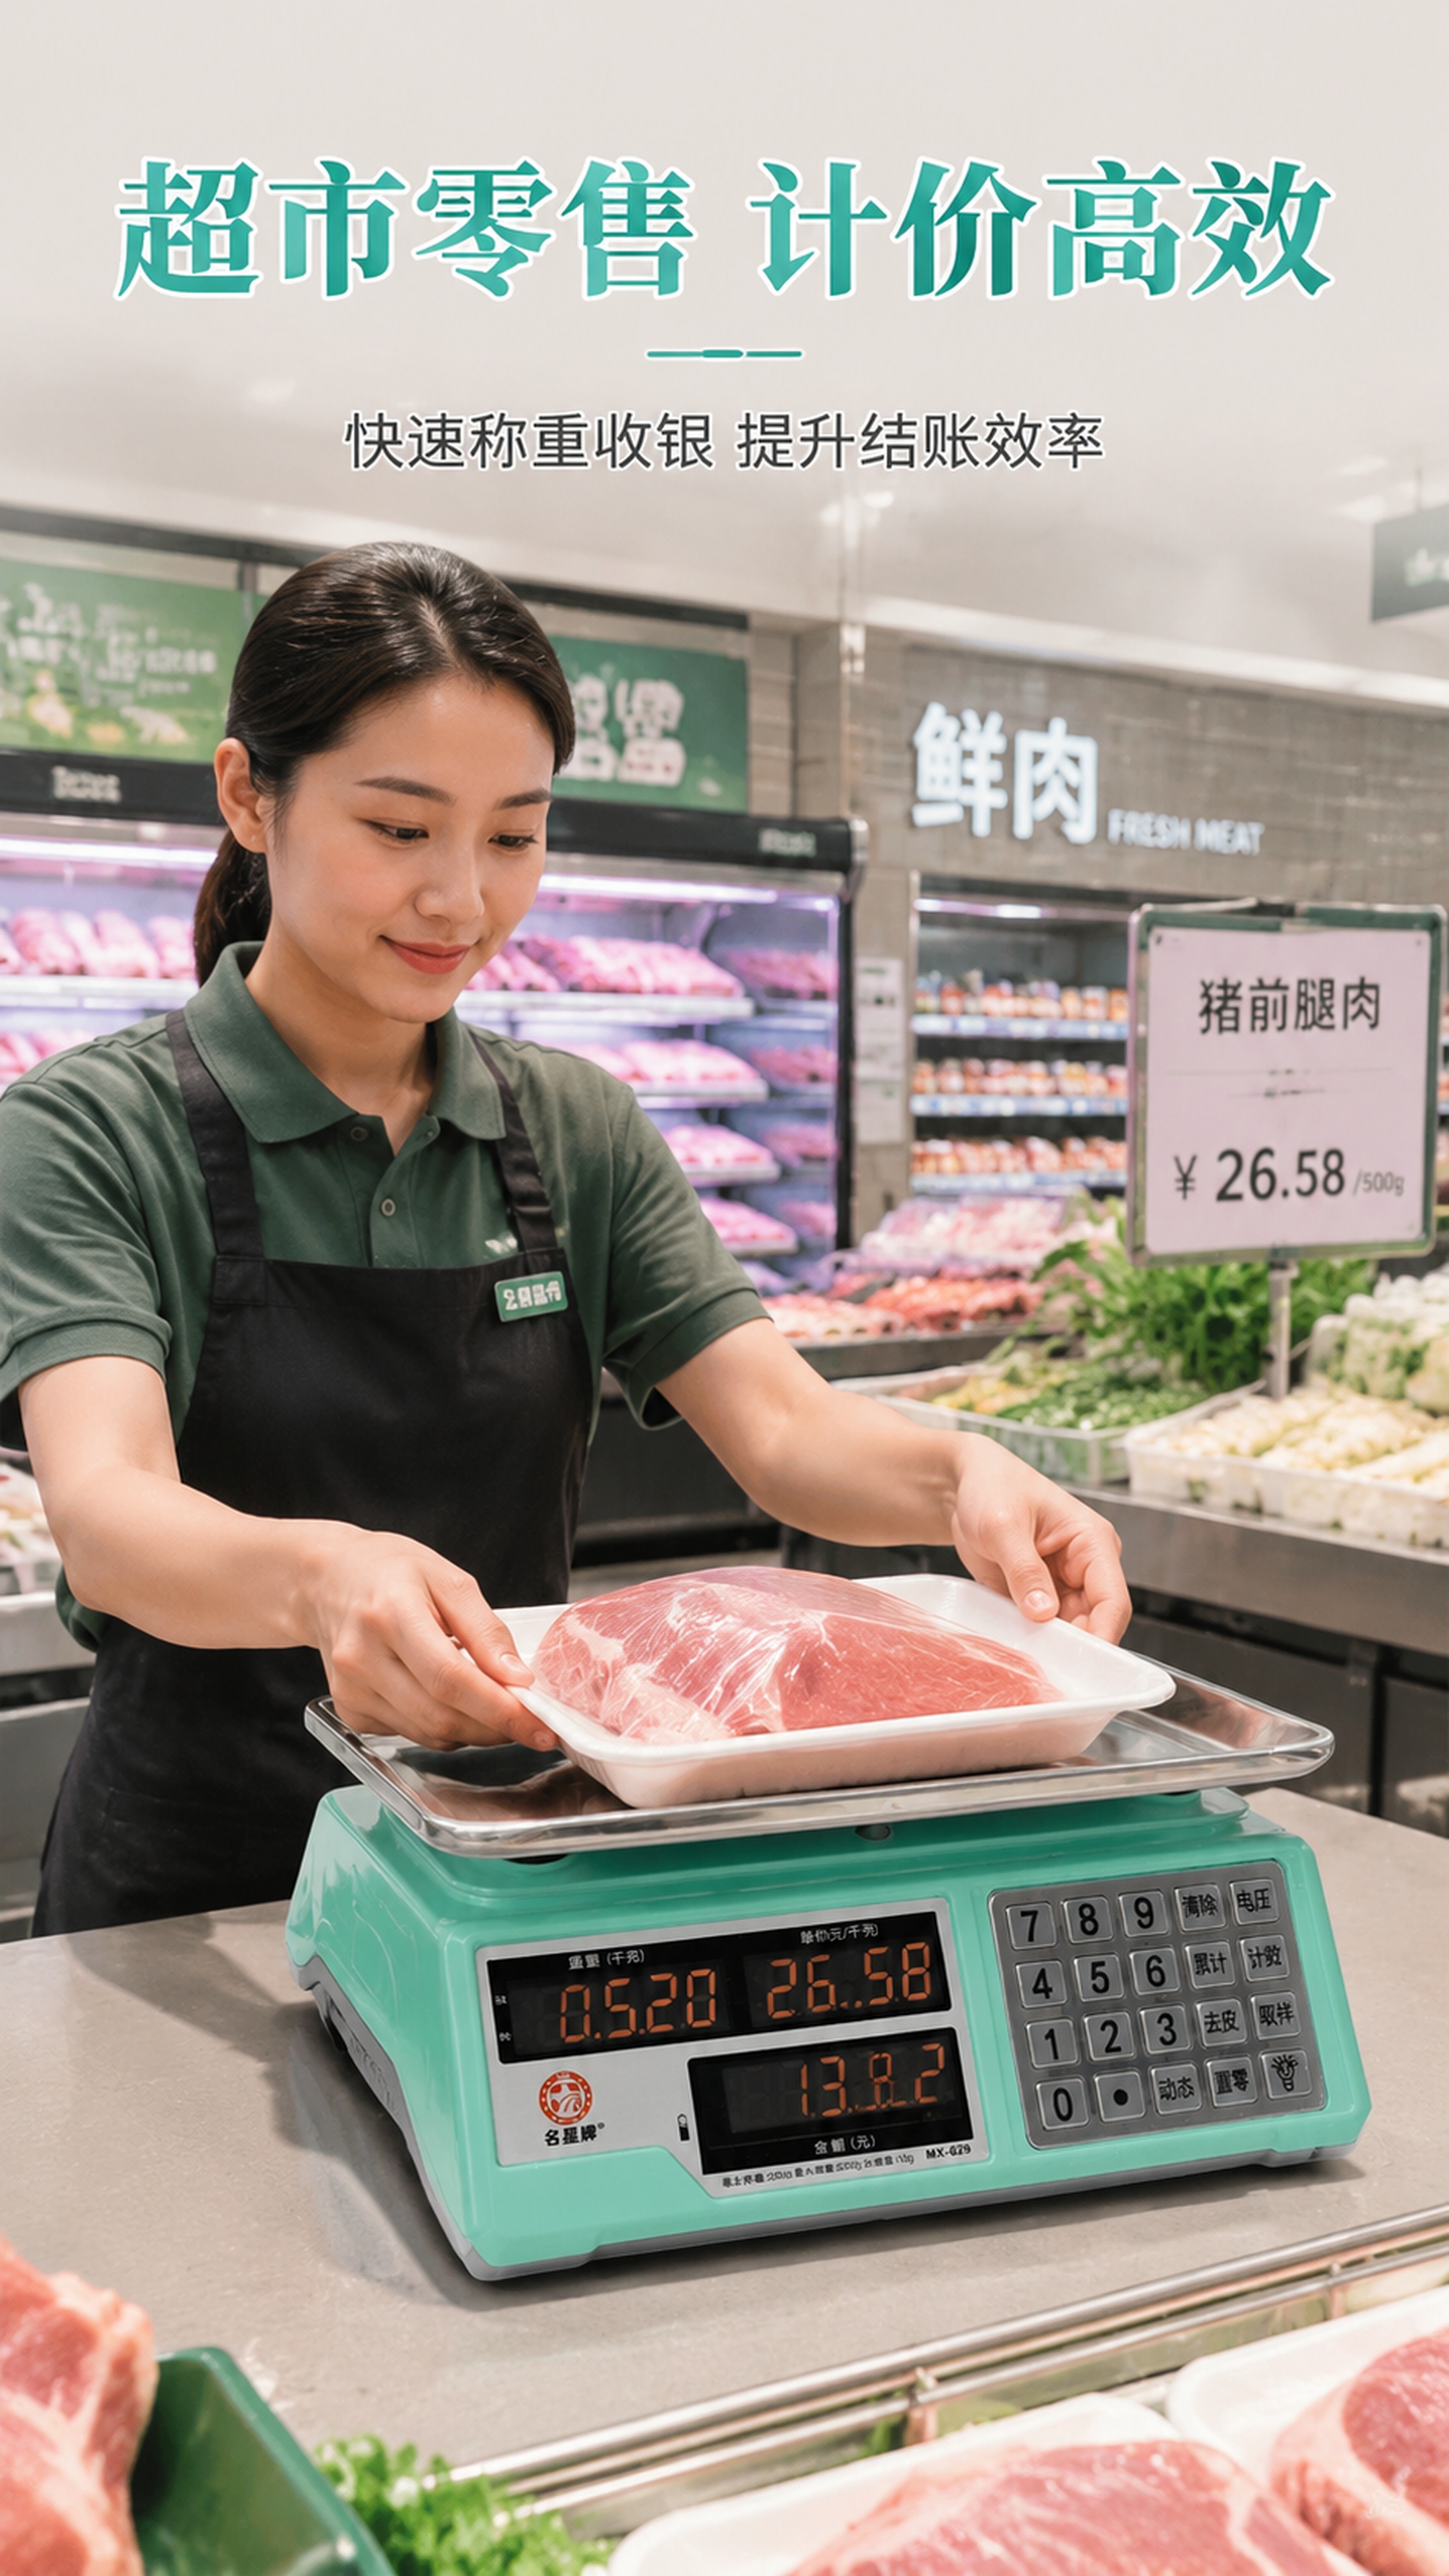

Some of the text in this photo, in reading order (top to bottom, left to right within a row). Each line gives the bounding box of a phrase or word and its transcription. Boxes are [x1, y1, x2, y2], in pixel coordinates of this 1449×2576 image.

[912, 702, 1098, 844] 鲜肉
[1108, 808, 1265, 856] FRESH MEAT
[1197, 975, 1381, 1036] 猪前腿肉
[1215, 1146, 1346, 1203] 26.58
[1352, 1168, 1406, 1197] /500g
[1020, 1909, 1039, 1943] 7
[1077, 1902, 1099, 1936] 8
[1133, 1896, 1155, 1929] 9
[1236, 1888, 1271, 1913] 电压
[1032, 1967, 1053, 2000] 4
[1089, 1960, 1111, 1994] 5
[1145, 1954, 1166, 1987] 6
[1044, 2028, 1059, 2061] 1
[1099, 2019, 1122, 2054] 2
[1156, 2012, 1177, 2046] 3
[1203, 2009, 1240, 2034] 去皮
[1052, 2087, 1073, 2122] 0
[1158, 2077, 1195, 2101] 动态
